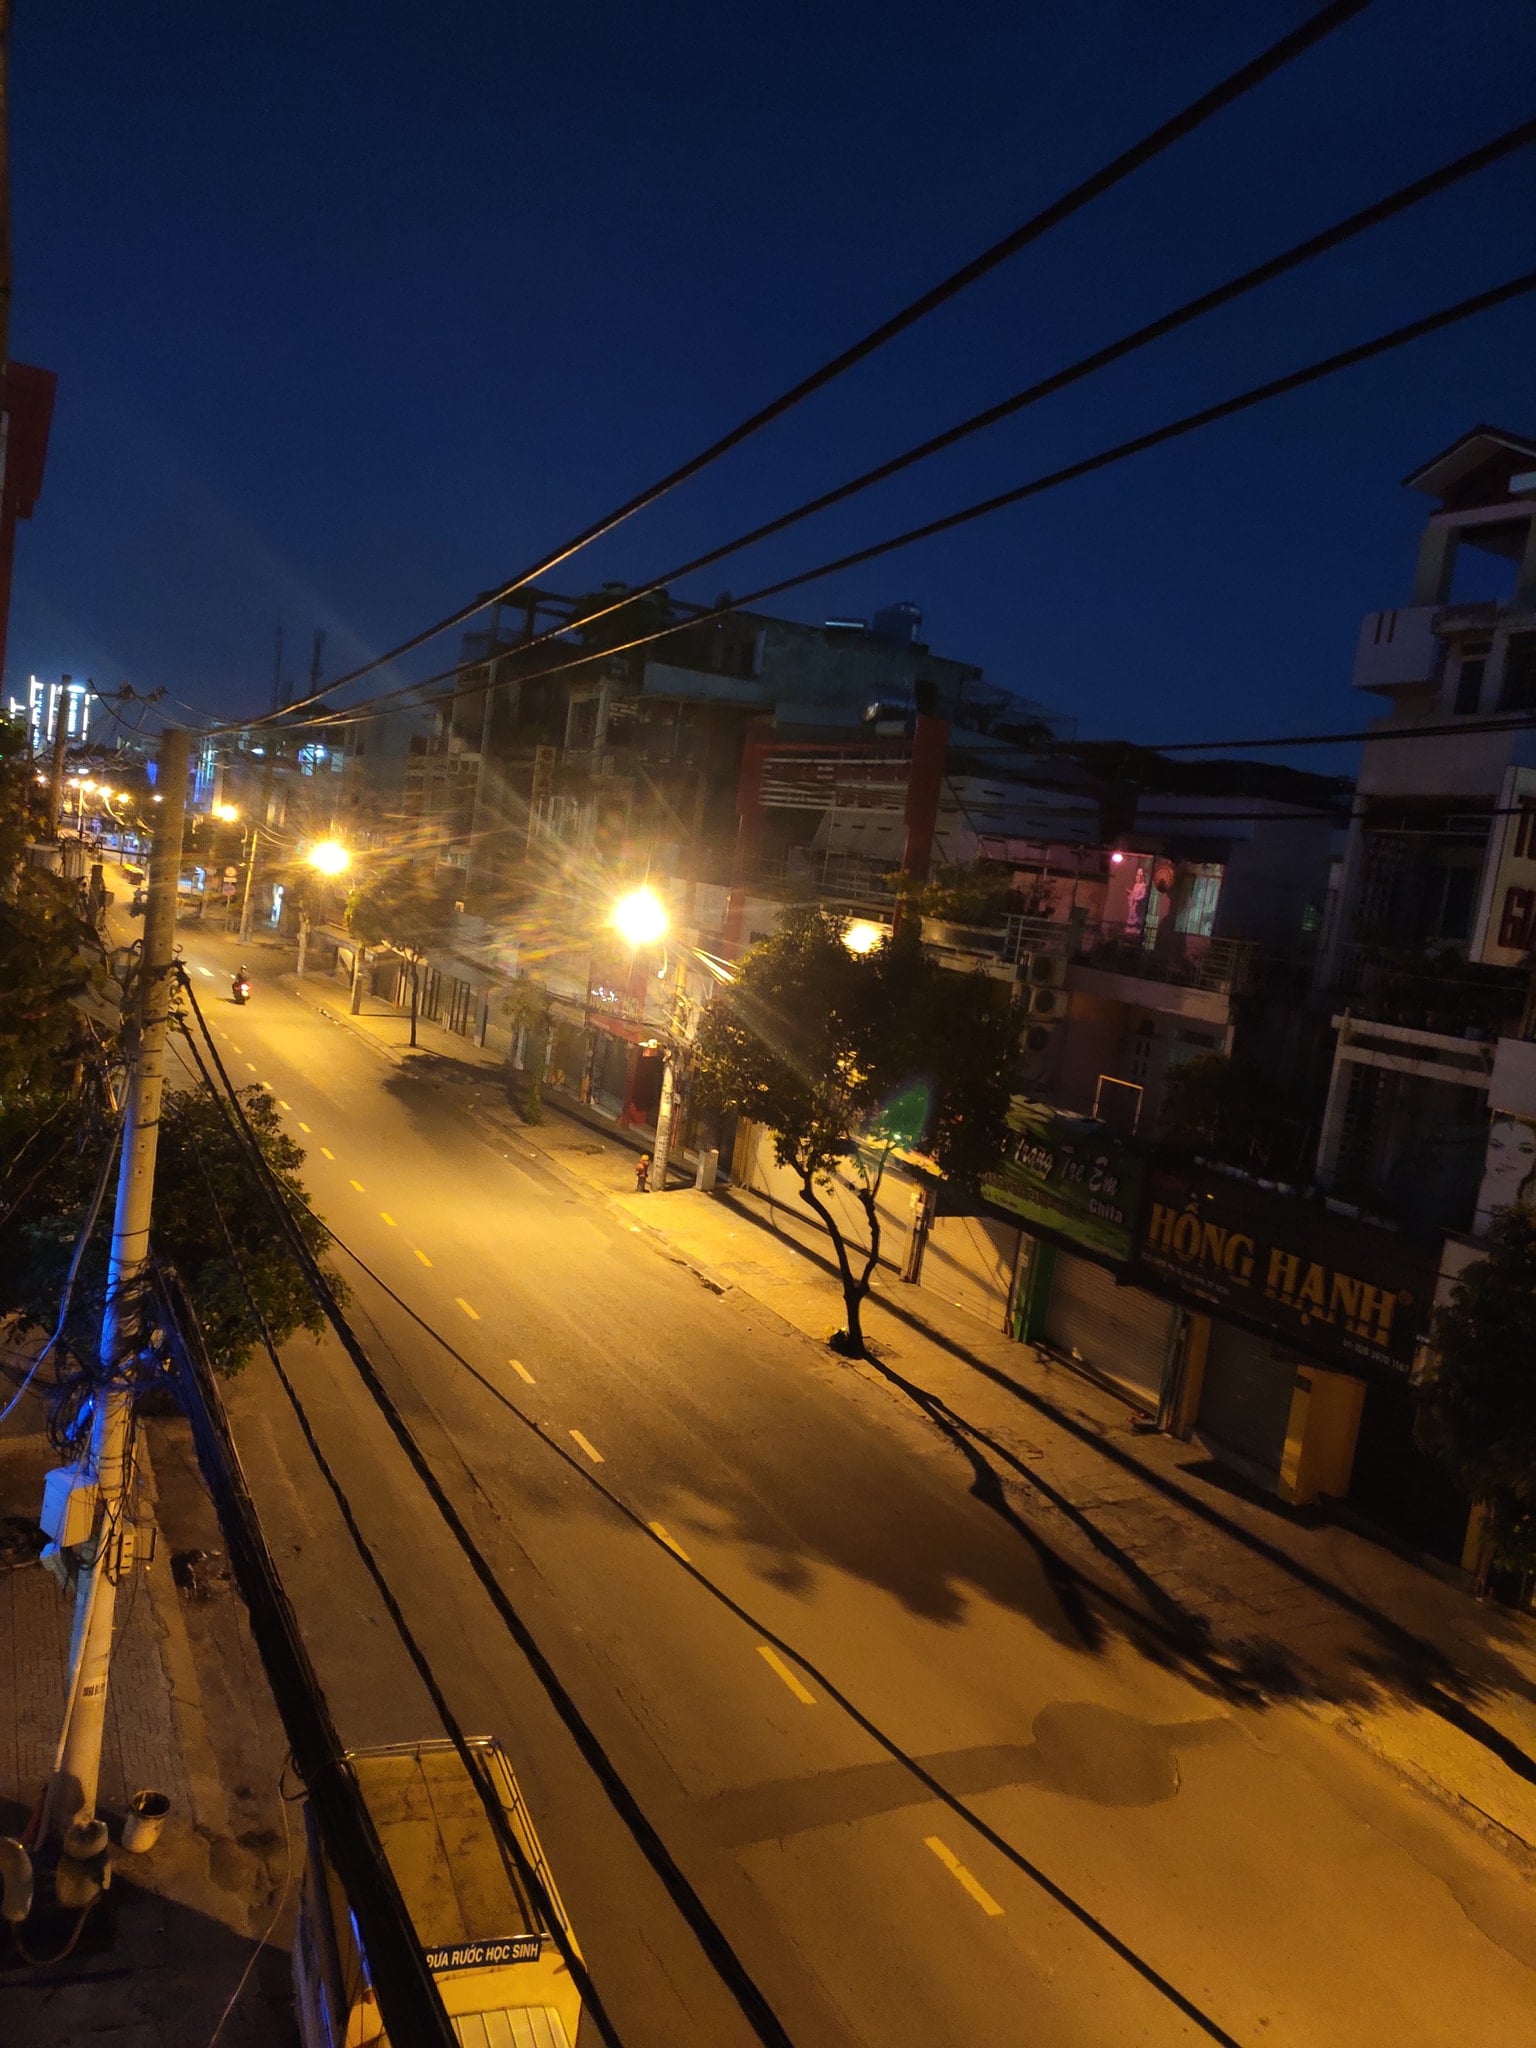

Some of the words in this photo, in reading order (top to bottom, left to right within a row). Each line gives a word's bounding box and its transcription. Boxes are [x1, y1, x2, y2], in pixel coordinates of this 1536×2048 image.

[1263, 1246, 1398, 1347] HẠNH
[485, 1944, 511, 1963] HỌC
[512, 1942, 539, 1959] SINH
